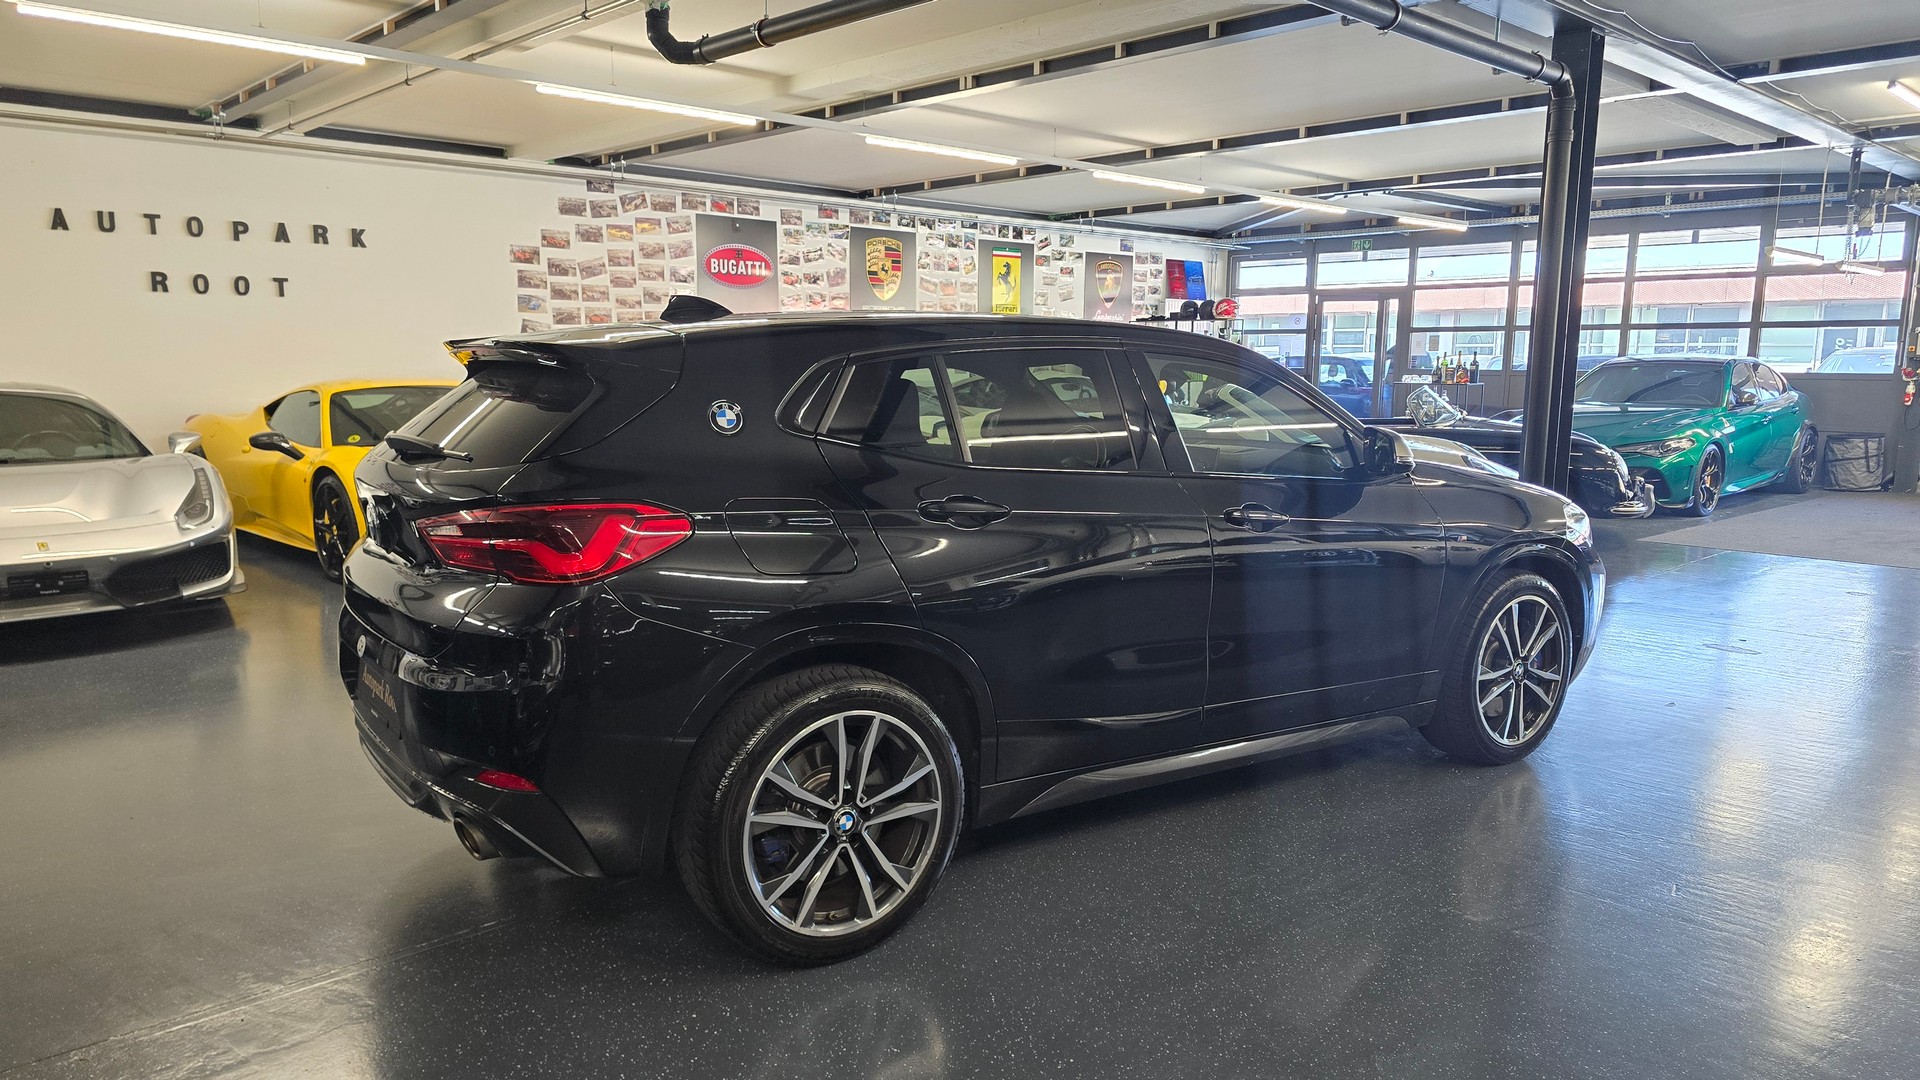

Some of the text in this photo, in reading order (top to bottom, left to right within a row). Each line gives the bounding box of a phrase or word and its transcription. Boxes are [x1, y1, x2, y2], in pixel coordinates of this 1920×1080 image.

[50, 208, 367, 248] AUTOPARK
[710, 258, 767, 276] BUGATTI
[150, 271, 289, 298] ROOT
[995, 303, 1018, 313] Ferrari
